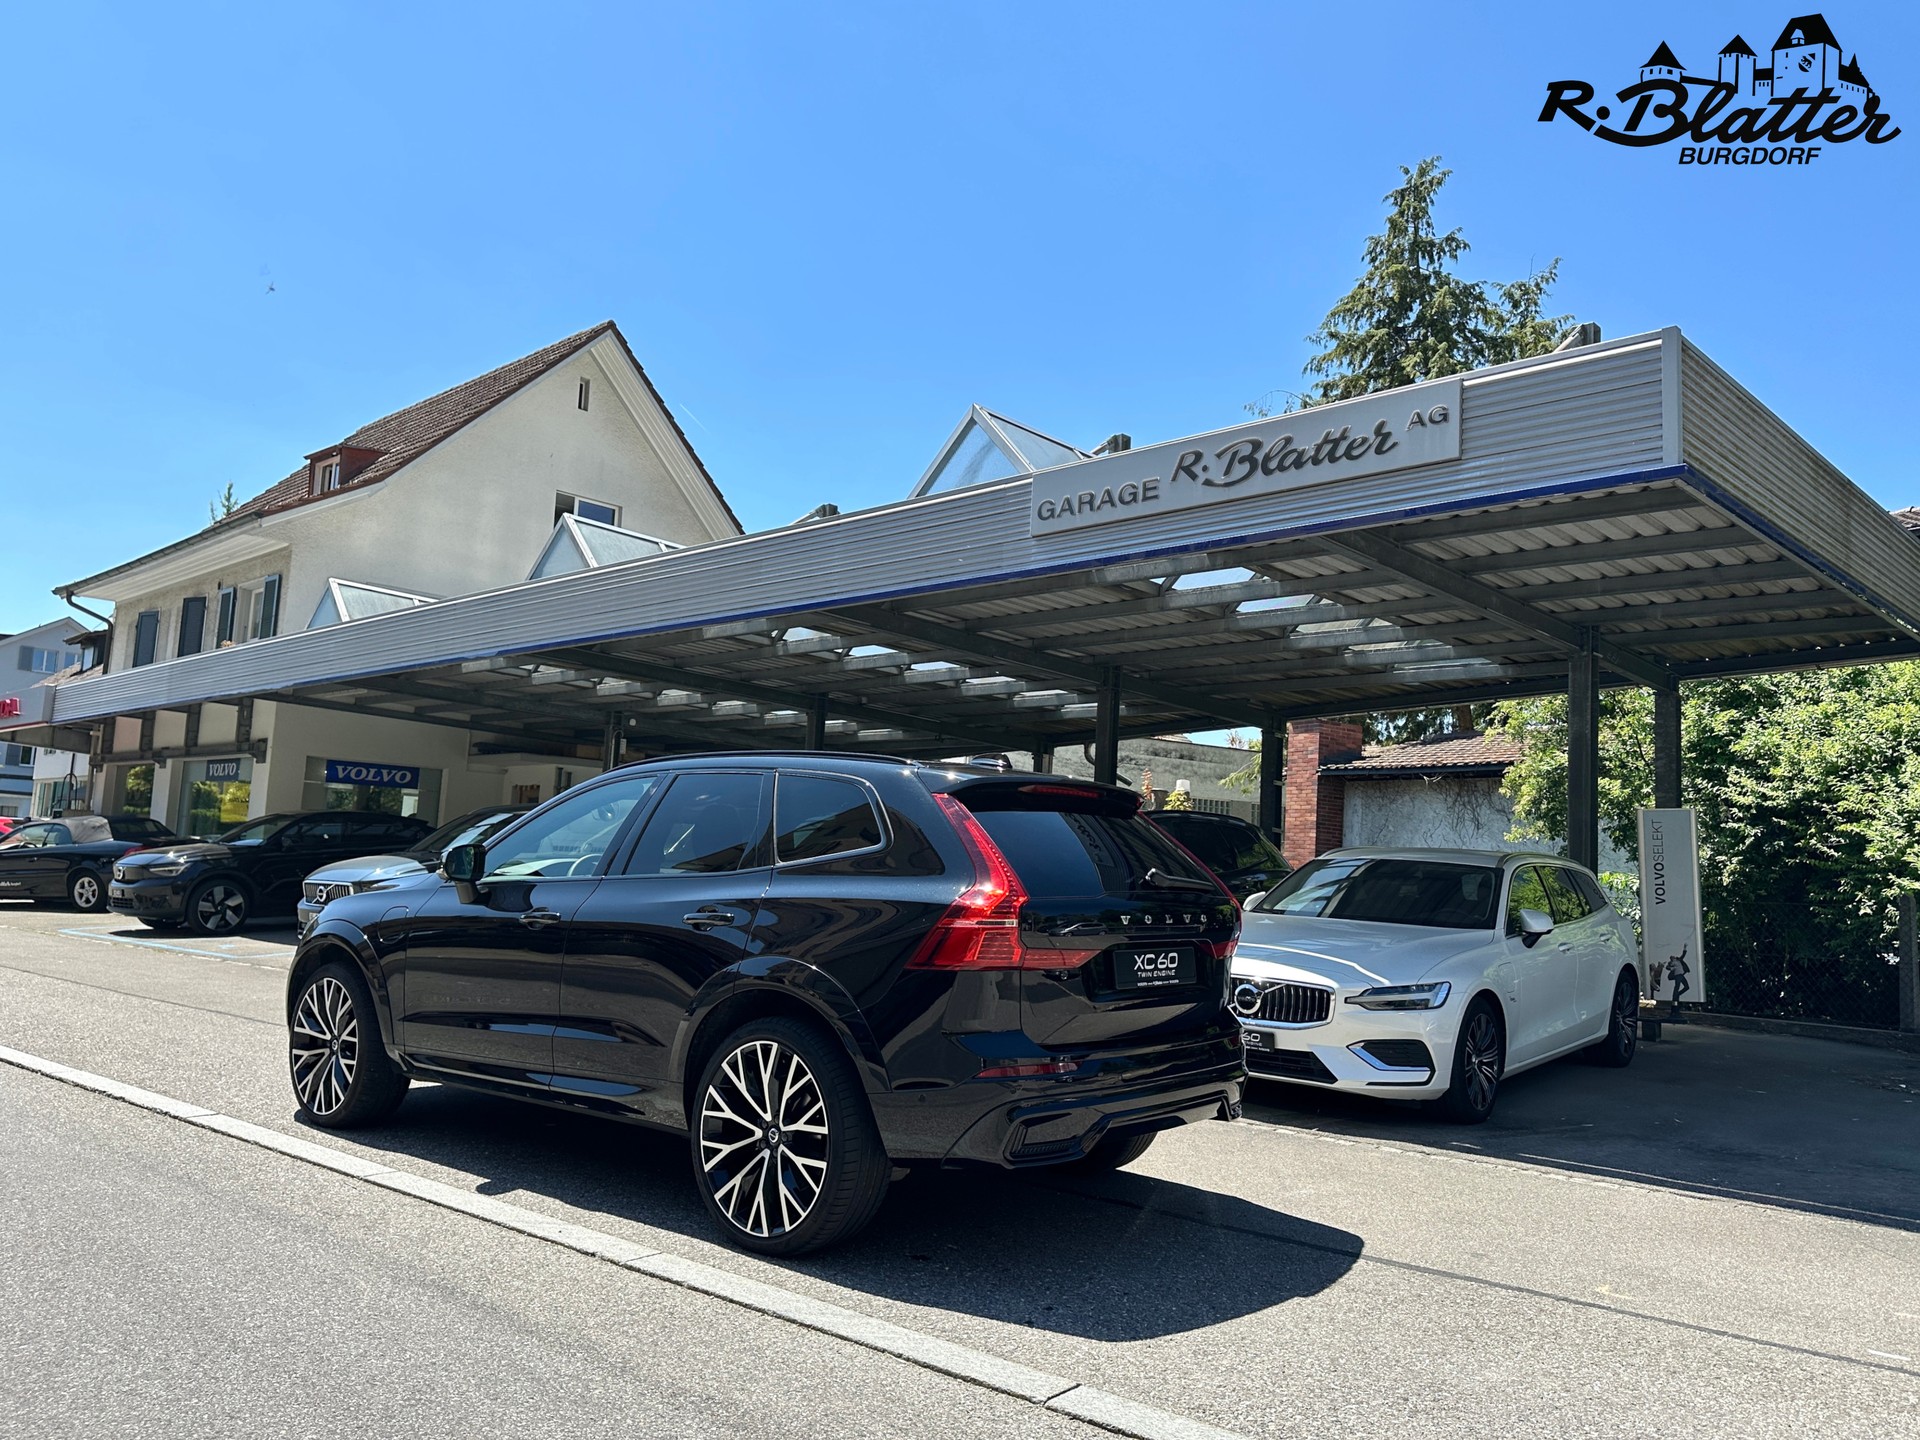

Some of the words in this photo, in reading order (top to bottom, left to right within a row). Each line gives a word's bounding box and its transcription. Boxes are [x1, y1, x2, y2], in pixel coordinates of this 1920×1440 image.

[1037, 477, 1161, 521] GARAGE
[1405, 404, 1450, 431] AG
[209, 763, 236, 776] VOLVO
[335, 765, 412, 784] VOLVO
[1651, 818, 1666, 905] VOLVOSELEKT
[1120, 915, 1207, 925] VOLVO
[1133, 952, 1178, 970] XC60
[1242, 1032, 1261, 1042] 60
